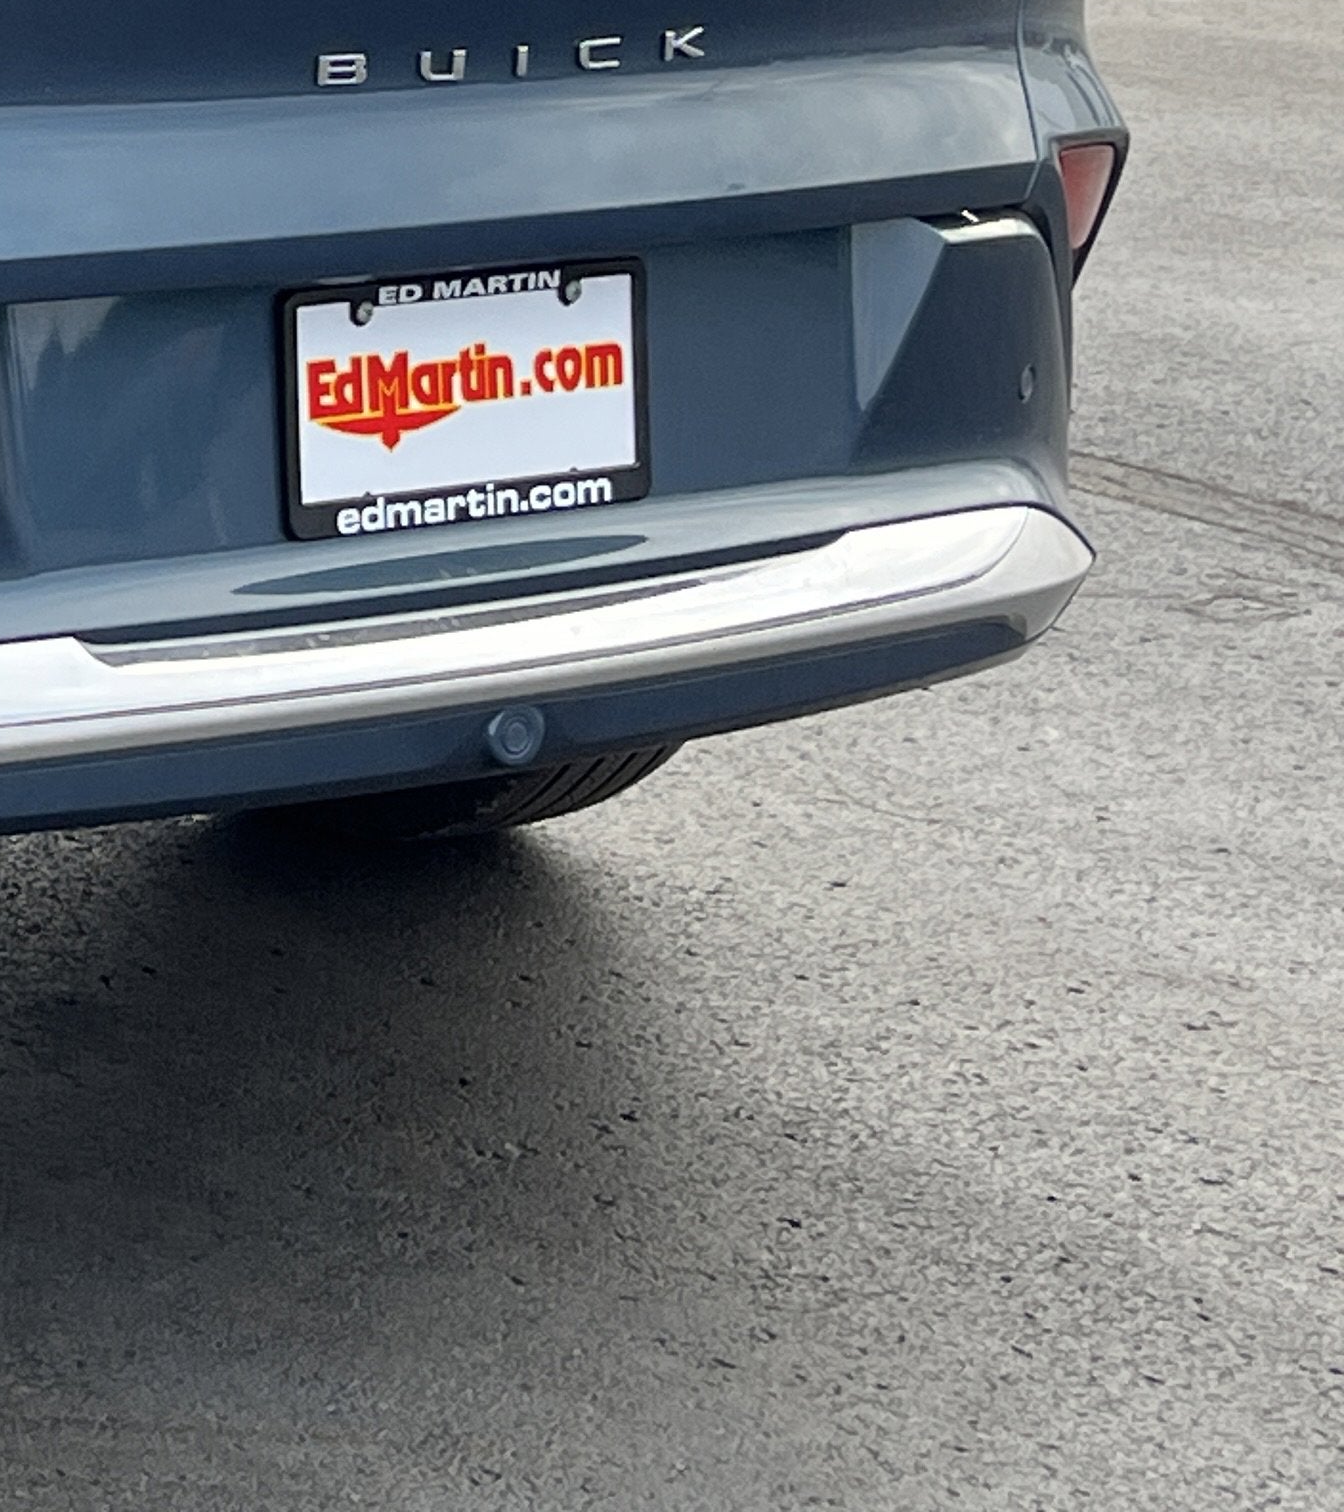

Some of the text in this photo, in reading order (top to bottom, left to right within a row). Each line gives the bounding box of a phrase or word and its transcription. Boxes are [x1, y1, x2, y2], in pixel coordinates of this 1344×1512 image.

[317, 26, 705, 86] BUICK
[378, 269, 562, 305] ED MARTIN
[307, 341, 624, 420] EdMartin.com
[336, 476, 612, 535] edmartin.com
